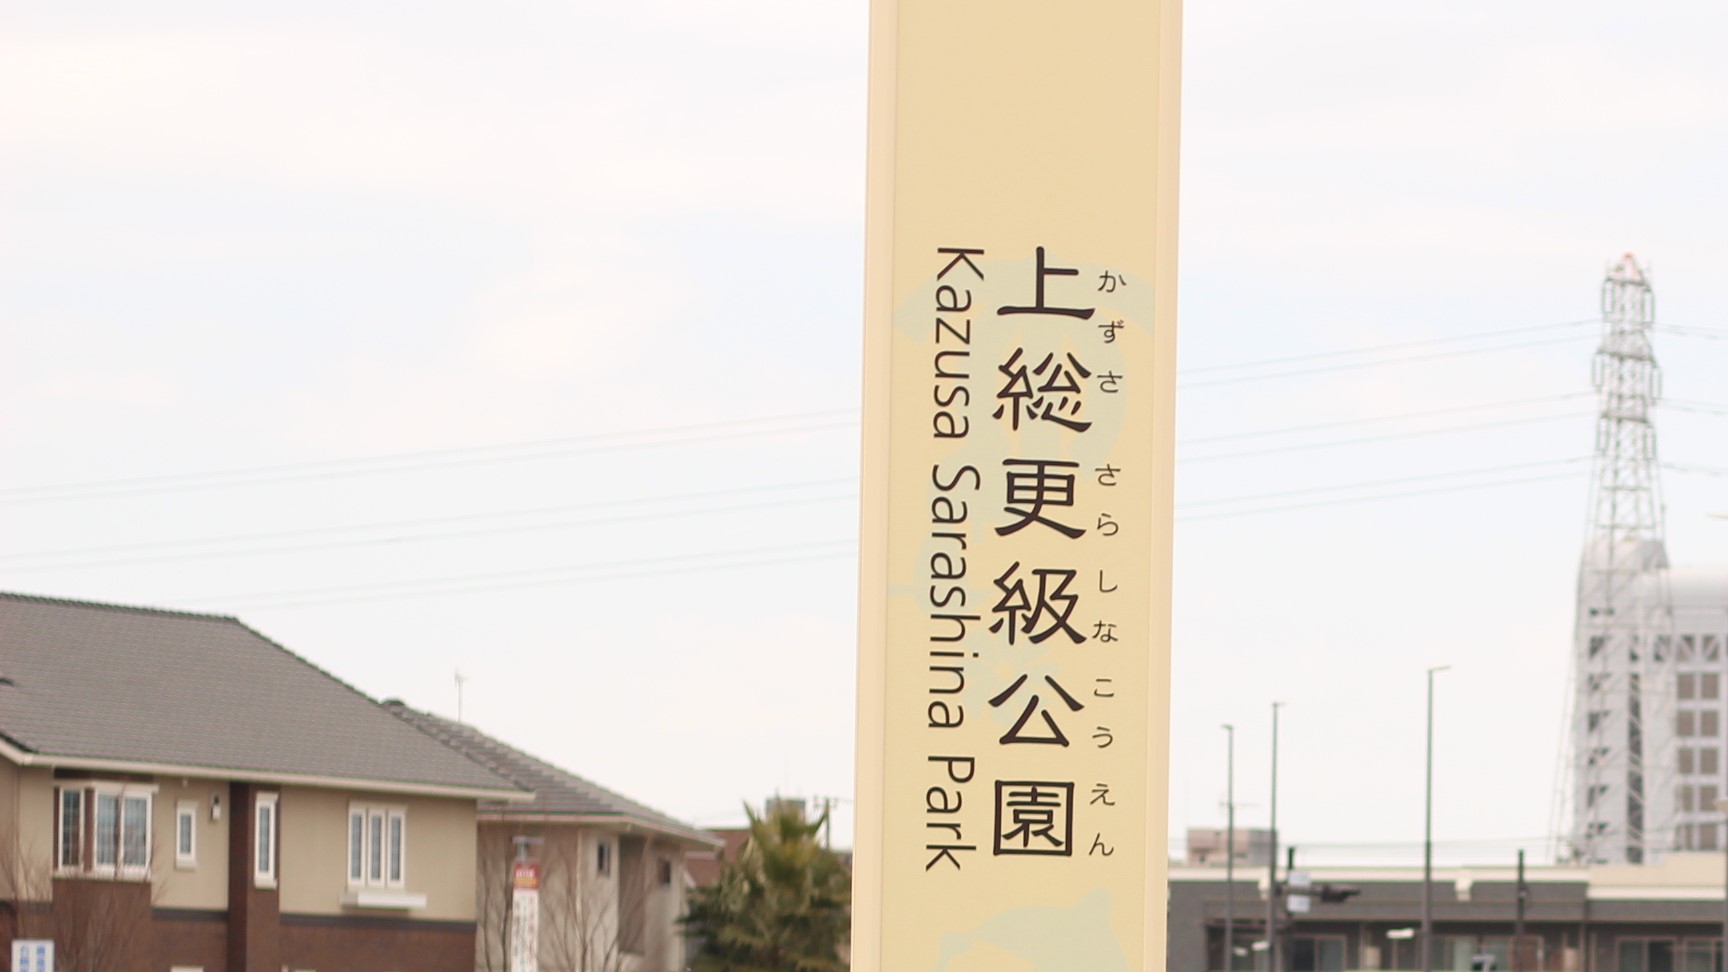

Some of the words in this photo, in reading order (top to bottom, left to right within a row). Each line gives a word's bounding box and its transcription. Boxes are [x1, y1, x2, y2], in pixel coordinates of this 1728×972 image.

[932, 246, 985, 441] Kazusa
[926, 464, 982, 731] Sarashina
[988, 246, 1096, 858] 上総更級公園
[924, 755, 977, 871] Park
